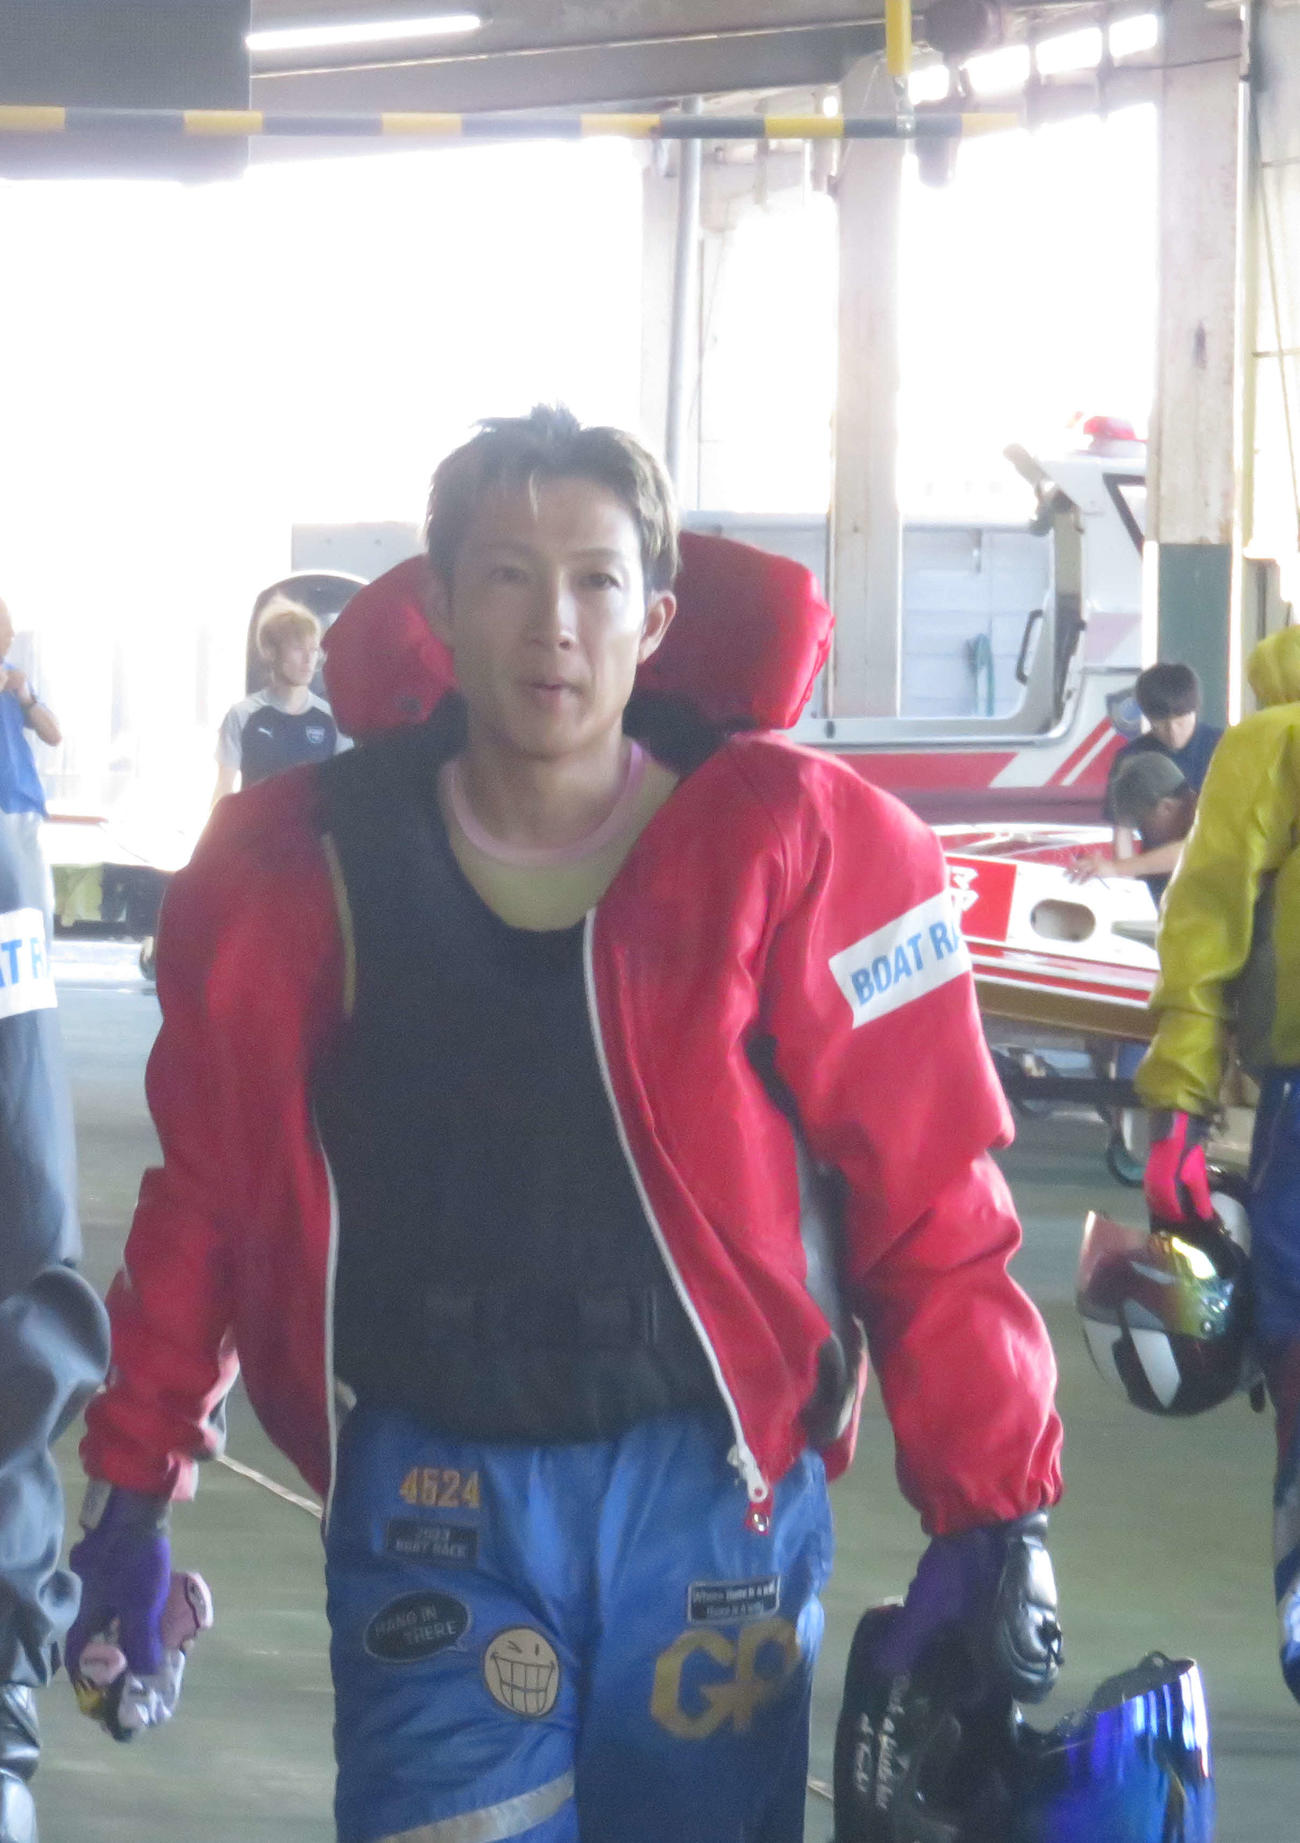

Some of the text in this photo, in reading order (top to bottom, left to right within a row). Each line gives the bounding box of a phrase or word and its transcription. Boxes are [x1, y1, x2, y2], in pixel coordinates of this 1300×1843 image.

[0, 939, 23, 988] T
[851, 932, 925, 1006] BOAT
[404, 1619, 458, 1645] THERE
